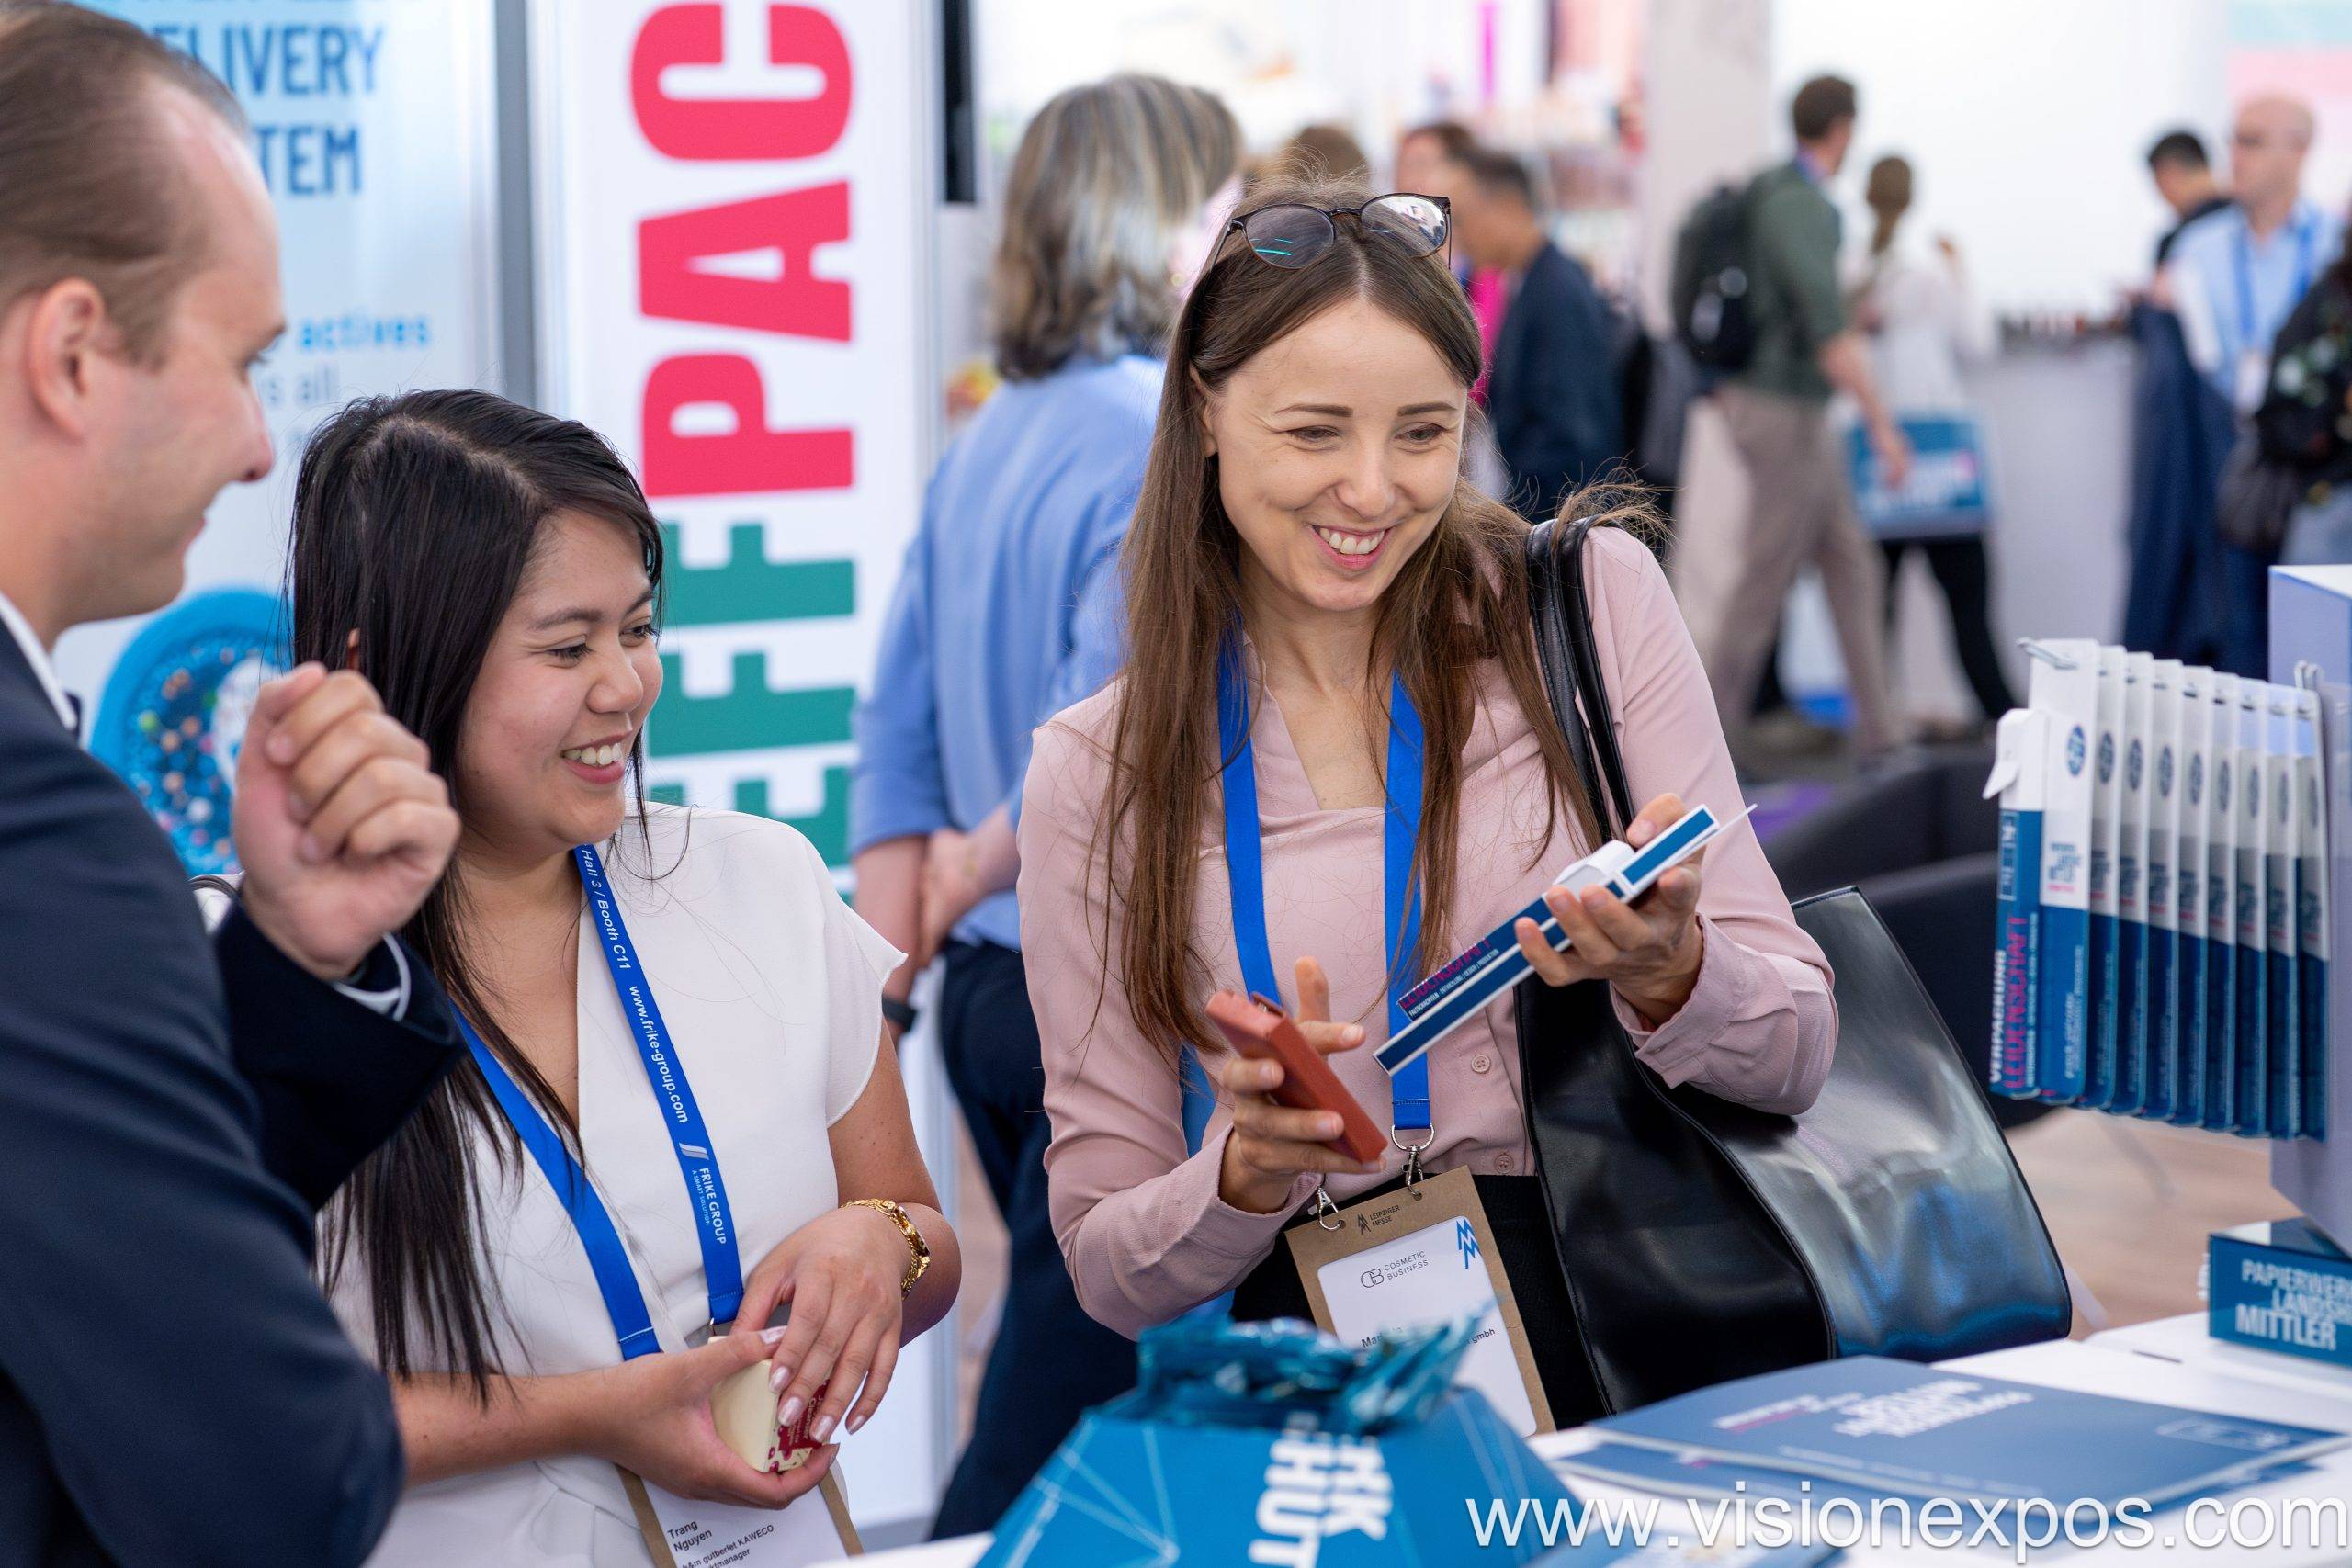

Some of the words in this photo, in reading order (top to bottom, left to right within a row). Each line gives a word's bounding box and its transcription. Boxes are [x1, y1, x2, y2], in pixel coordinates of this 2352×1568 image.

[253, 127, 361, 196] TEM
[630, 3, 855, 905] EFFPAC
[582, 849, 598, 876] Hall
[591, 880, 602, 888] 3
[597, 899, 619, 941] Booth
[613, 944, 631, 970] C11
[628, 986, 688, 1123] www.frike-group.com
[694, 1176, 703, 1194] SMART
[699, 1196, 710, 1225] SOLUTION
[699, 1168, 717, 1200] FRIKE
[708, 1201, 727, 1244] GROUP
[1369, 1204, 1401, 1221] LEIPZIGER
[1372, 1215, 1393, 1227] MESSE
[1384, 1250, 1426, 1271] COSMETIC
[1386, 1259, 1429, 1280] BUSINESS
[1472, 1328, 1496, 1343] gmbh
[2234, 1303, 2337, 1351] MITTLER
[1322, 1435, 1394, 1541] RK
[667, 1520, 698, 1539] Trang
[673, 1529, 713, 1552] Nguyen
[737, 1524, 775, 1546] KAWECO
